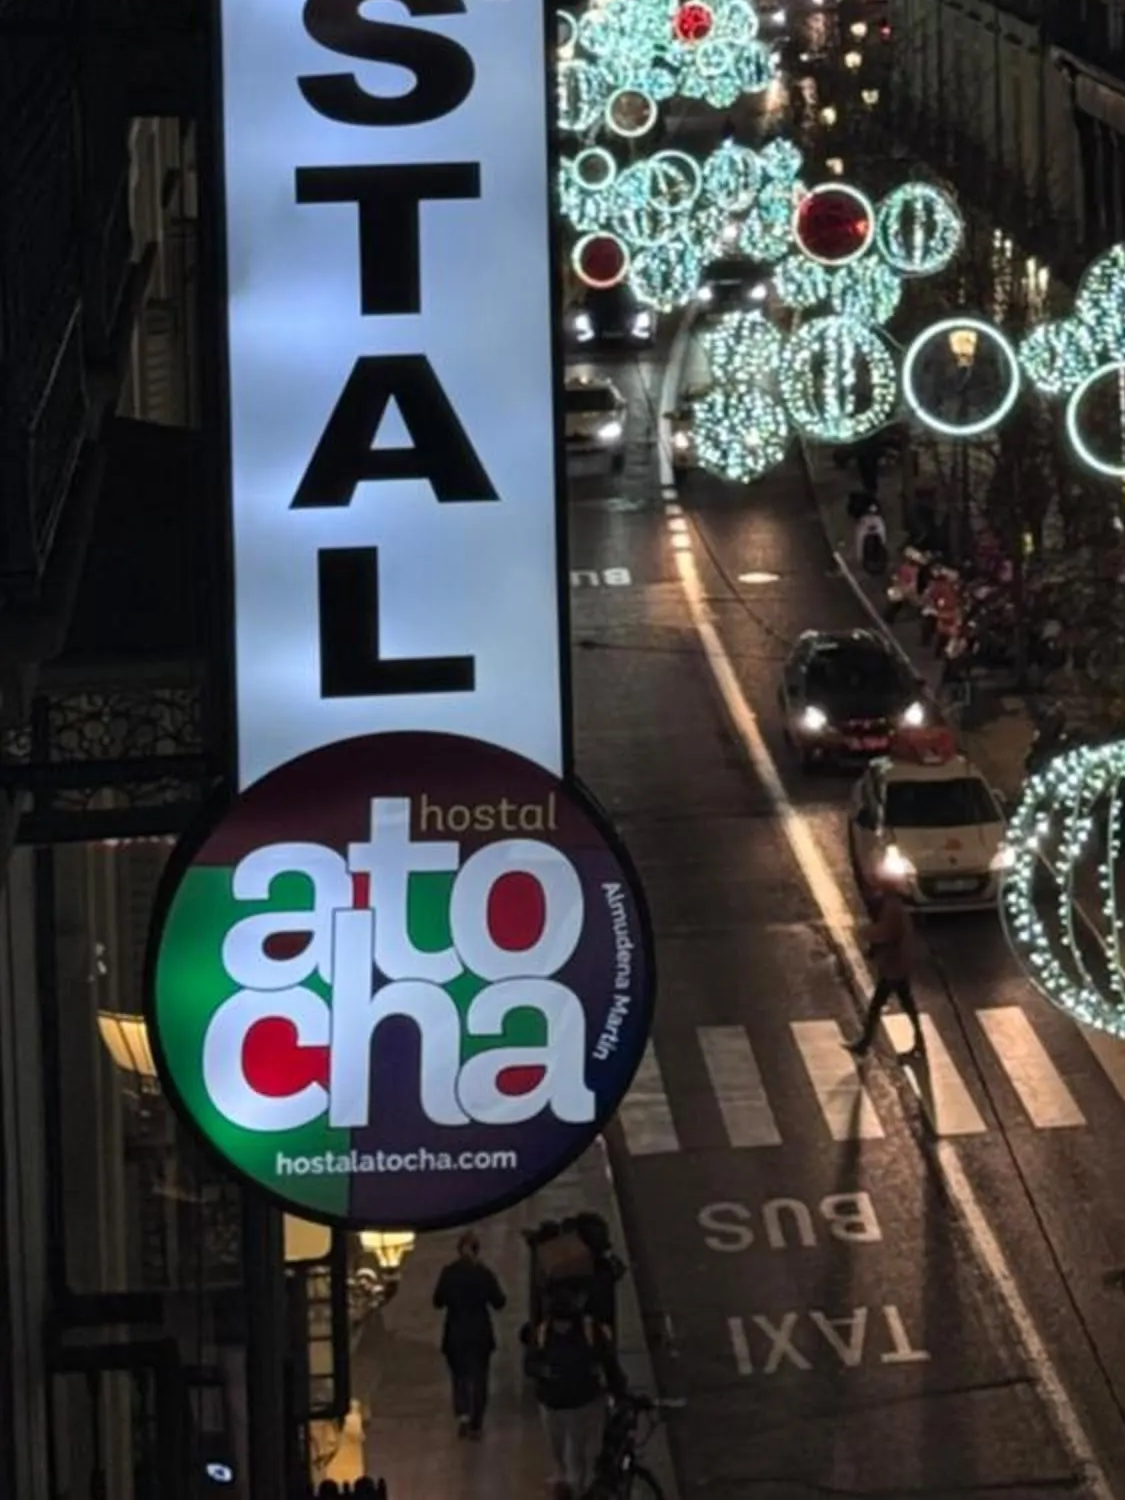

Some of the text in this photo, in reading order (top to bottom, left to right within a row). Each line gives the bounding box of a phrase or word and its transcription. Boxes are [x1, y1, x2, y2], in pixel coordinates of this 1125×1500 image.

[570, 567, 632, 587] BU
[420, 794, 557, 831] hostal
[602, 881, 634, 991] Almudena
[276, 1148, 517, 1176] hostalatocha.com
[699, 1192, 883, 1252] BUS
[728, 1305, 931, 1375] TAXI
